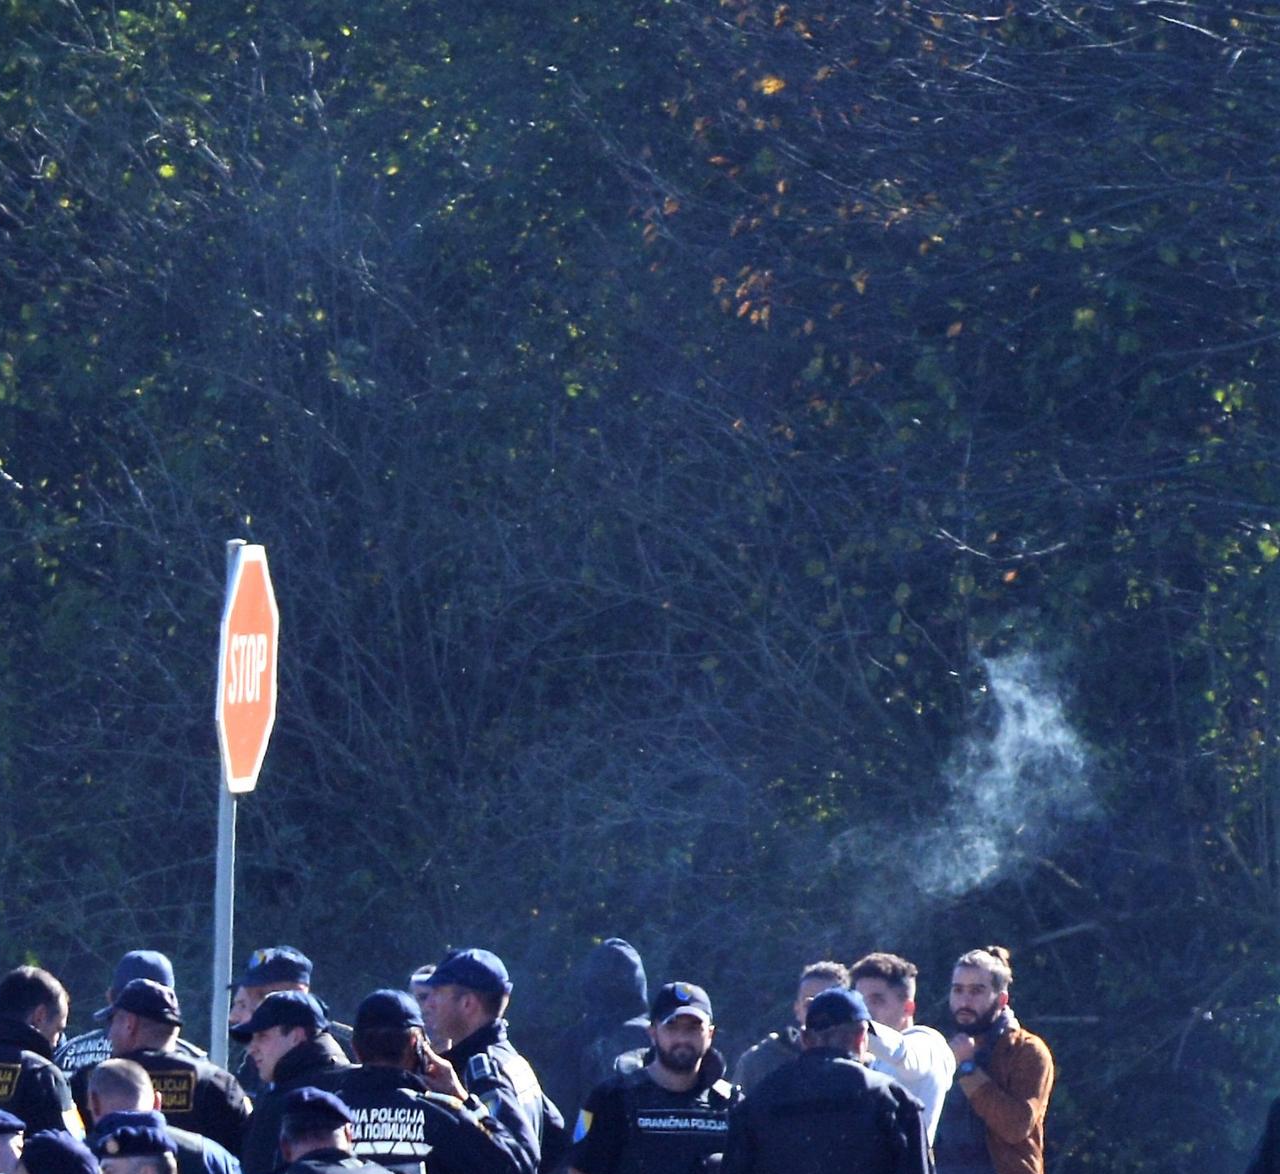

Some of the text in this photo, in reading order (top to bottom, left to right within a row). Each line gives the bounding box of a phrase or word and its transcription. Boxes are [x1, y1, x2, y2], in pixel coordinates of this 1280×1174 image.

[228, 633, 268, 705] STOP
[370, 1107, 425, 1125] POLICIJA
[638, 1115, 690, 1129] GRANIČNA
[363, 1123, 425, 1142] ПОЛИЦИЈА
